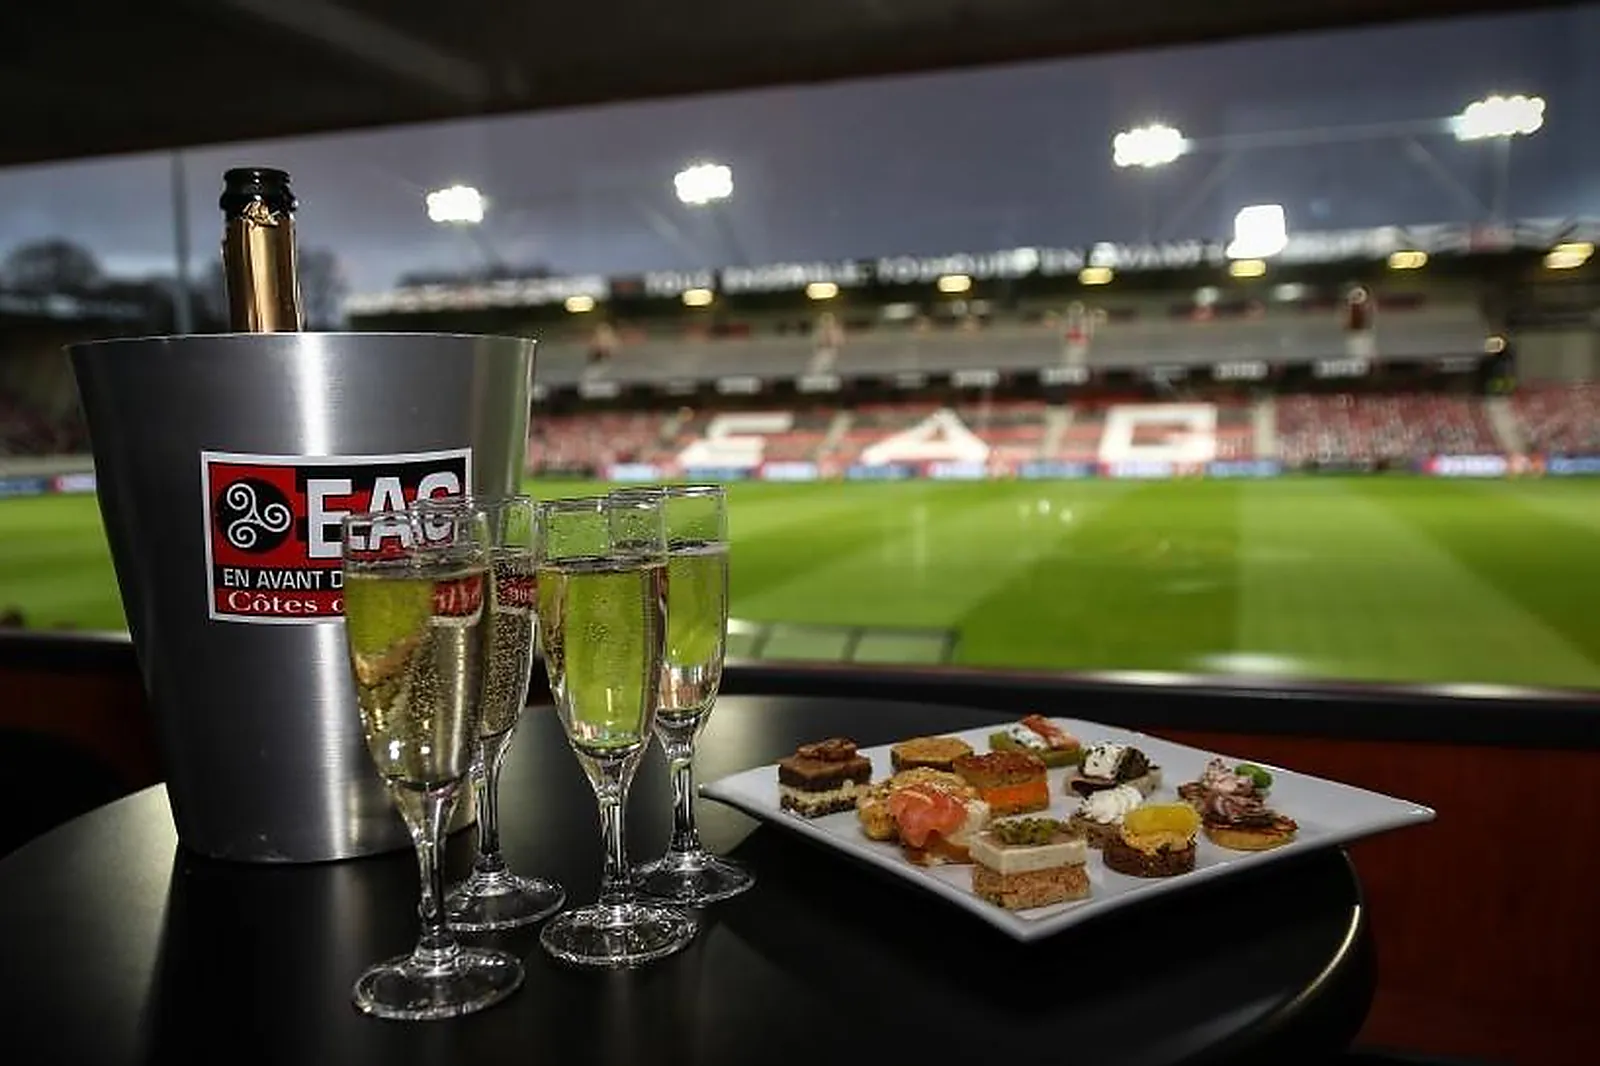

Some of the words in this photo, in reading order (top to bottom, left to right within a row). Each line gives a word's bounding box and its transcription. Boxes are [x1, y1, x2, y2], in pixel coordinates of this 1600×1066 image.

[223, 568, 250, 588] EN
[256, 570, 325, 590] AVANT
[330, 570, 344, 588] D
[228, 590, 318, 613] Côtes
